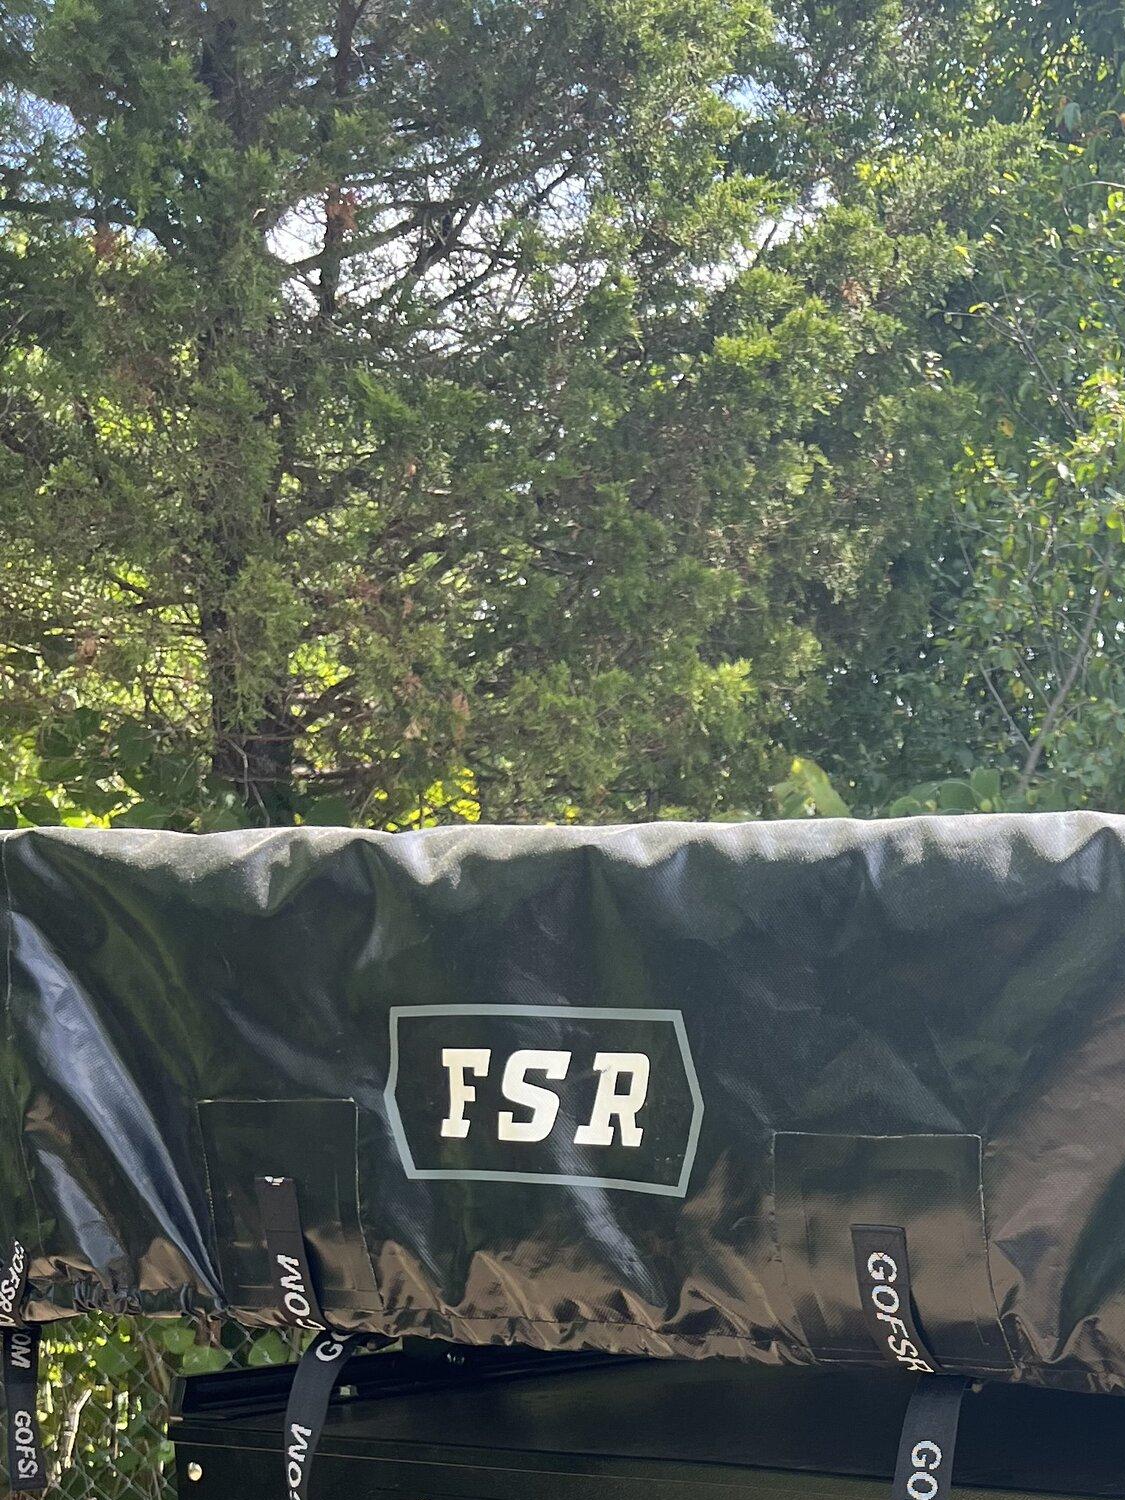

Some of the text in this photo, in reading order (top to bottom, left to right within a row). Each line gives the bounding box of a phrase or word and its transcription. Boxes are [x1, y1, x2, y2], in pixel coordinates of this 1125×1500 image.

[440, 1047, 650, 1147] FSR
[11, 1332, 32, 1369] OM
[867, 1251, 935, 1373] GOFSR
